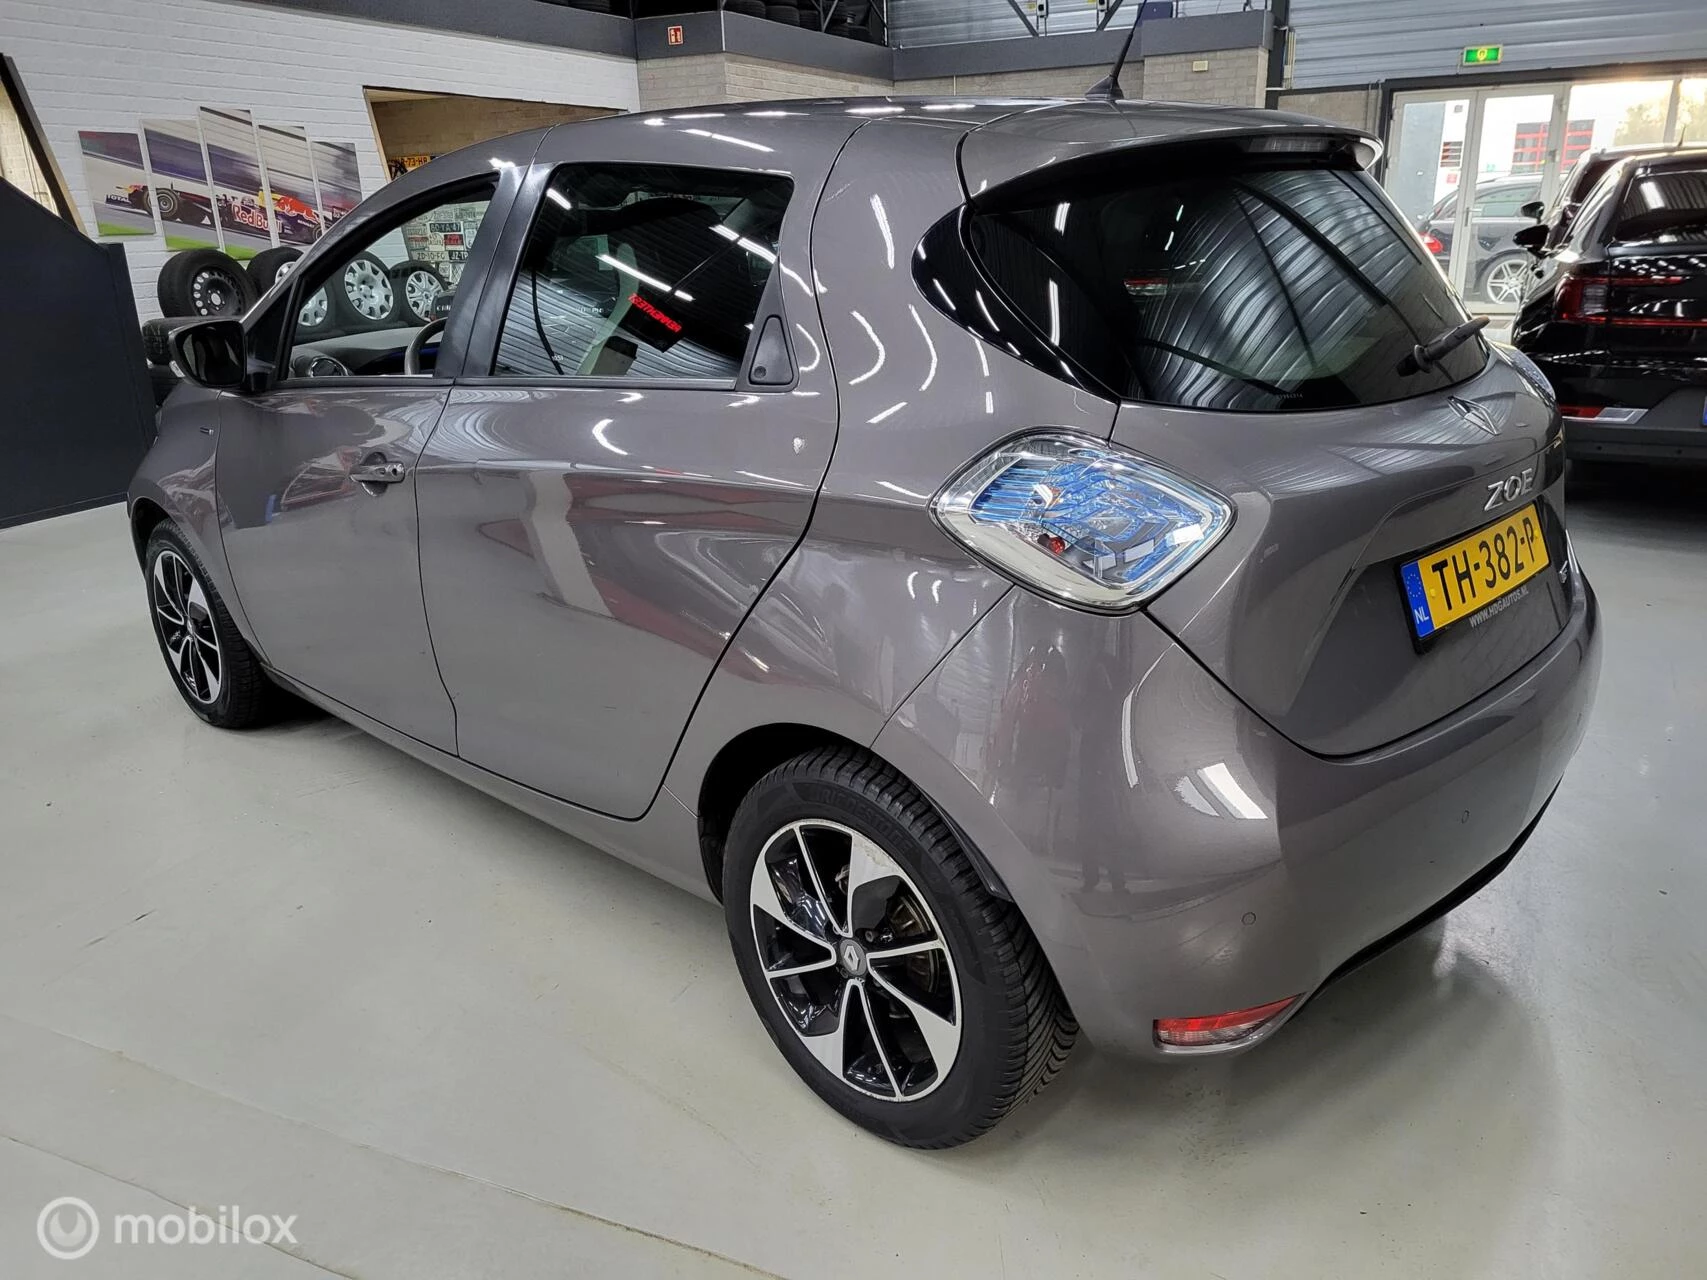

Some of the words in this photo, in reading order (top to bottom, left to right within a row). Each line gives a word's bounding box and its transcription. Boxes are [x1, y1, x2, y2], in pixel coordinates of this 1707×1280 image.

[231, 203, 255, 225] Red
[1484, 468, 1533, 512] ZOE
[1431, 517, 1535, 611] TH-382-P
[1413, 606, 1430, 625] NL
